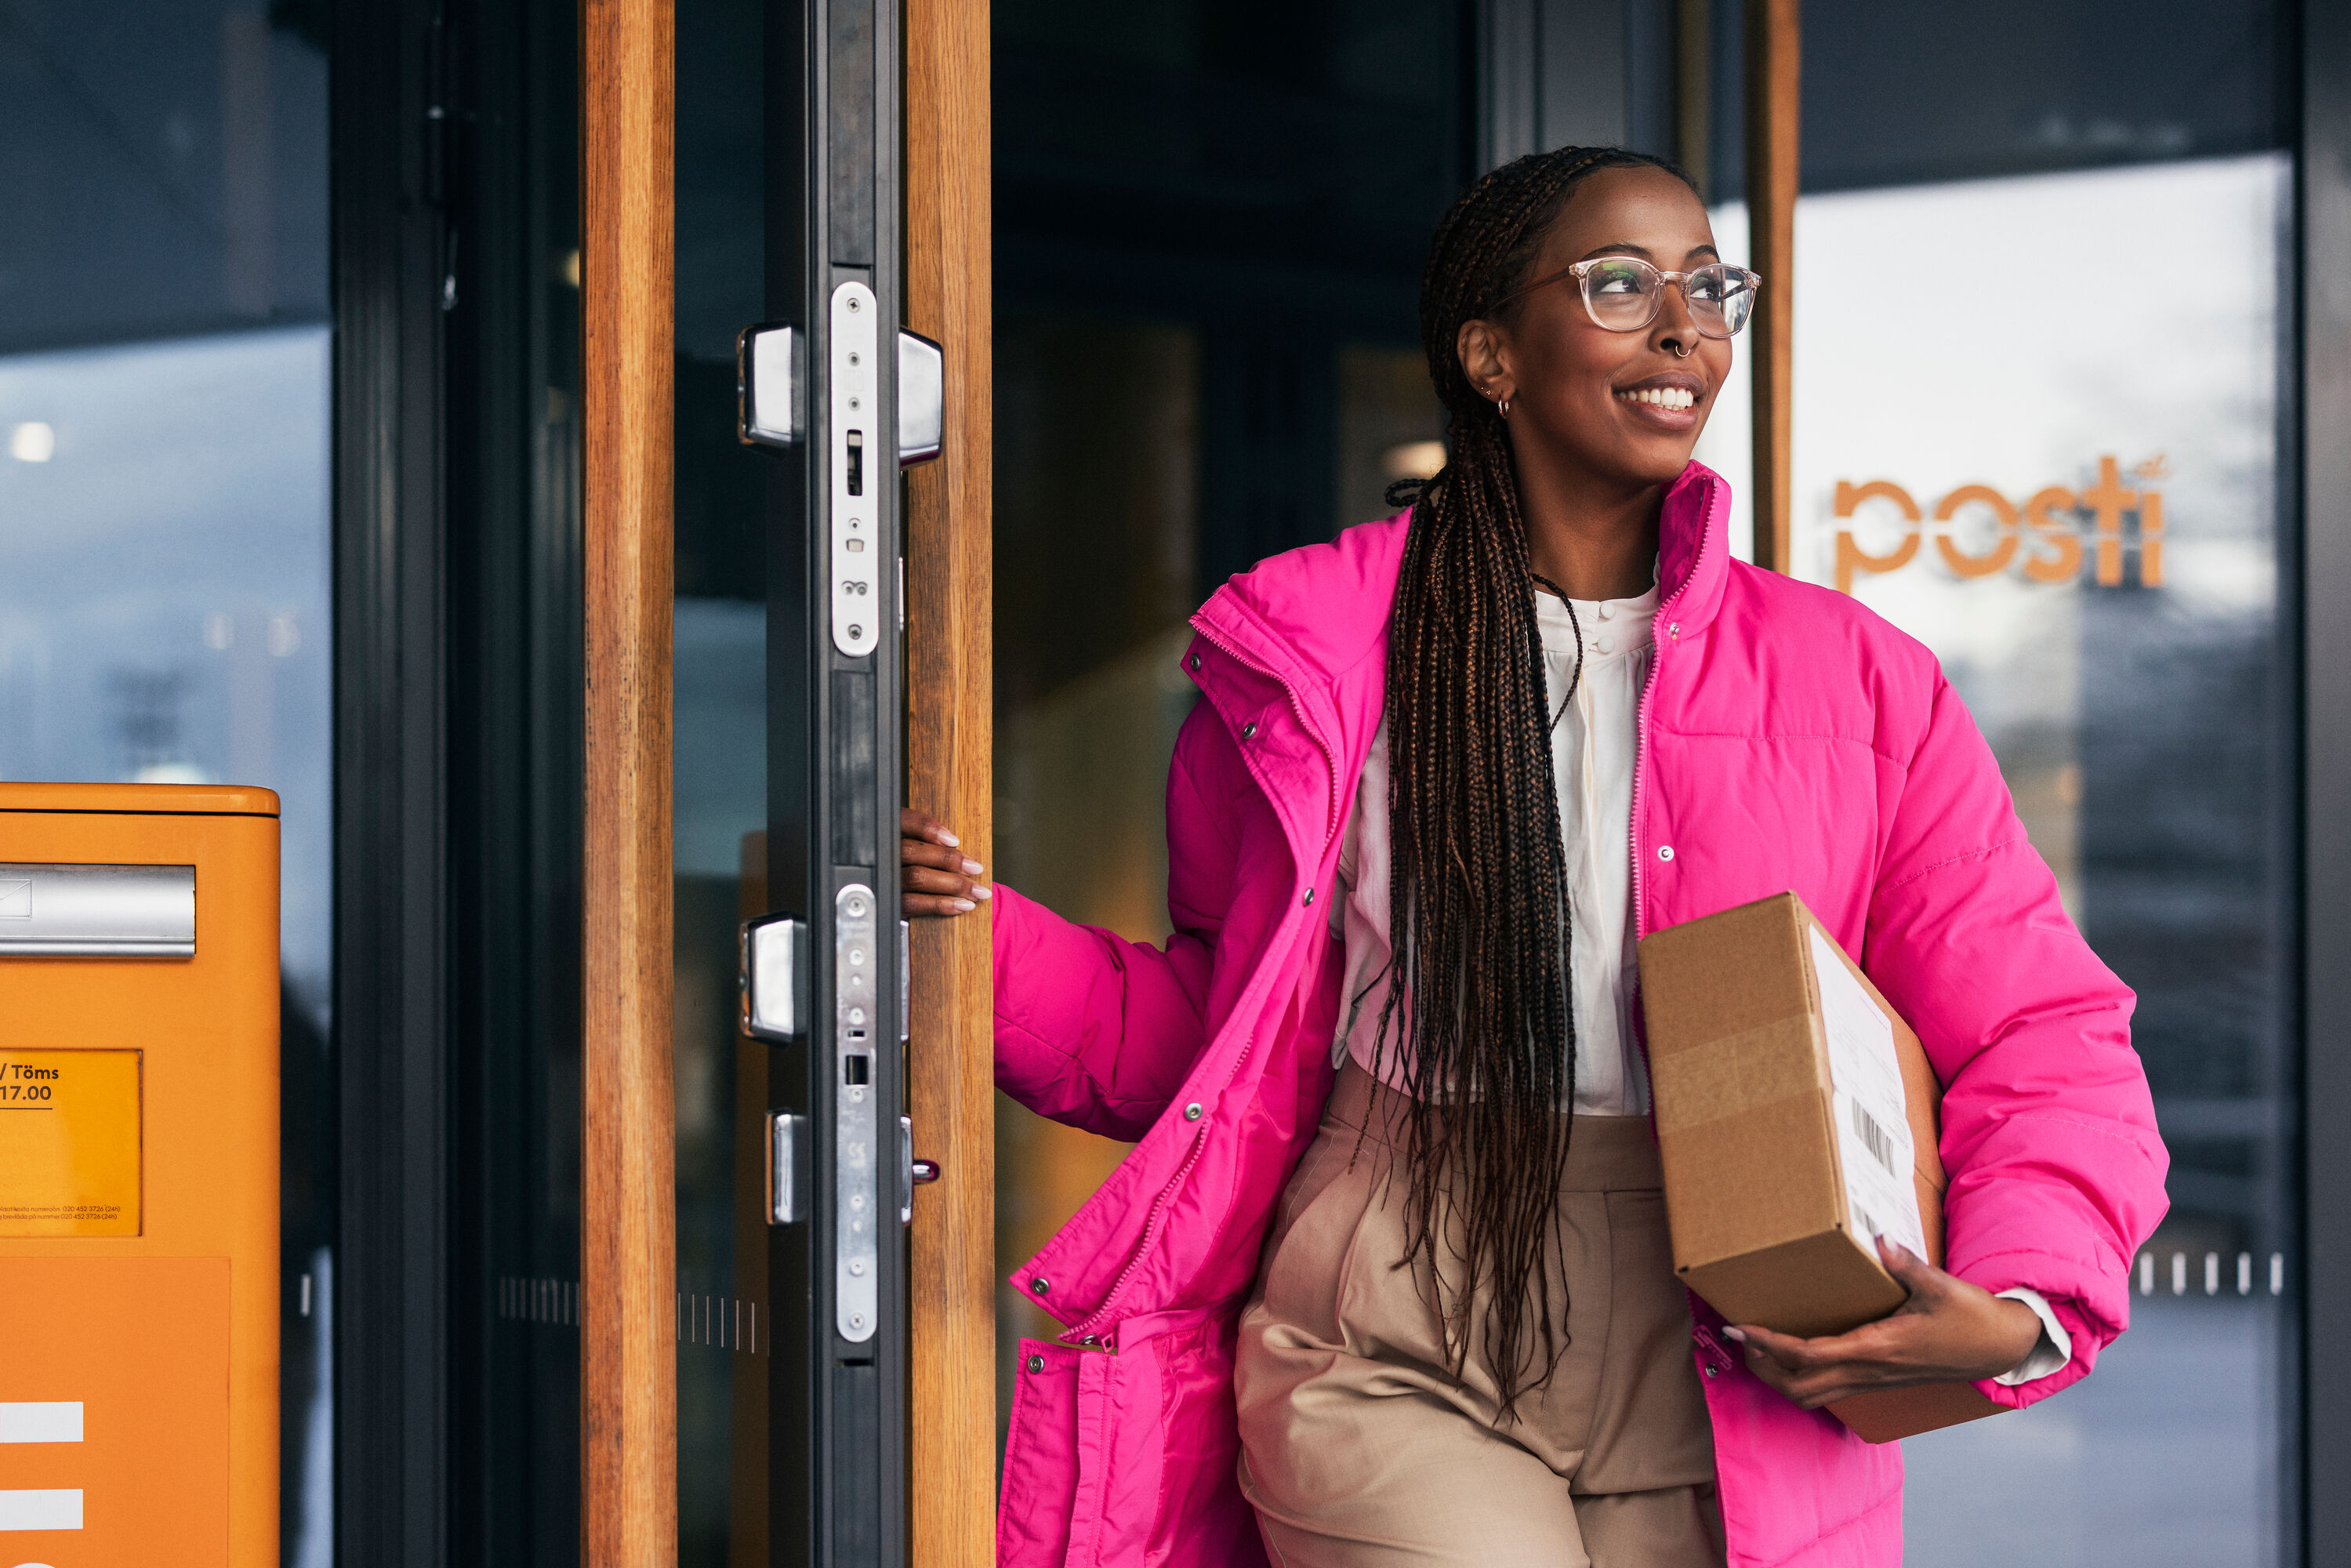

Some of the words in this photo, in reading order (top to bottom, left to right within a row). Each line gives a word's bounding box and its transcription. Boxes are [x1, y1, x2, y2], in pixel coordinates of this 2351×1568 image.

[1834, 452, 2164, 594] posti
[11, 1065, 59, 1080] Töms
[0, 1085, 52, 1100] 17.00
